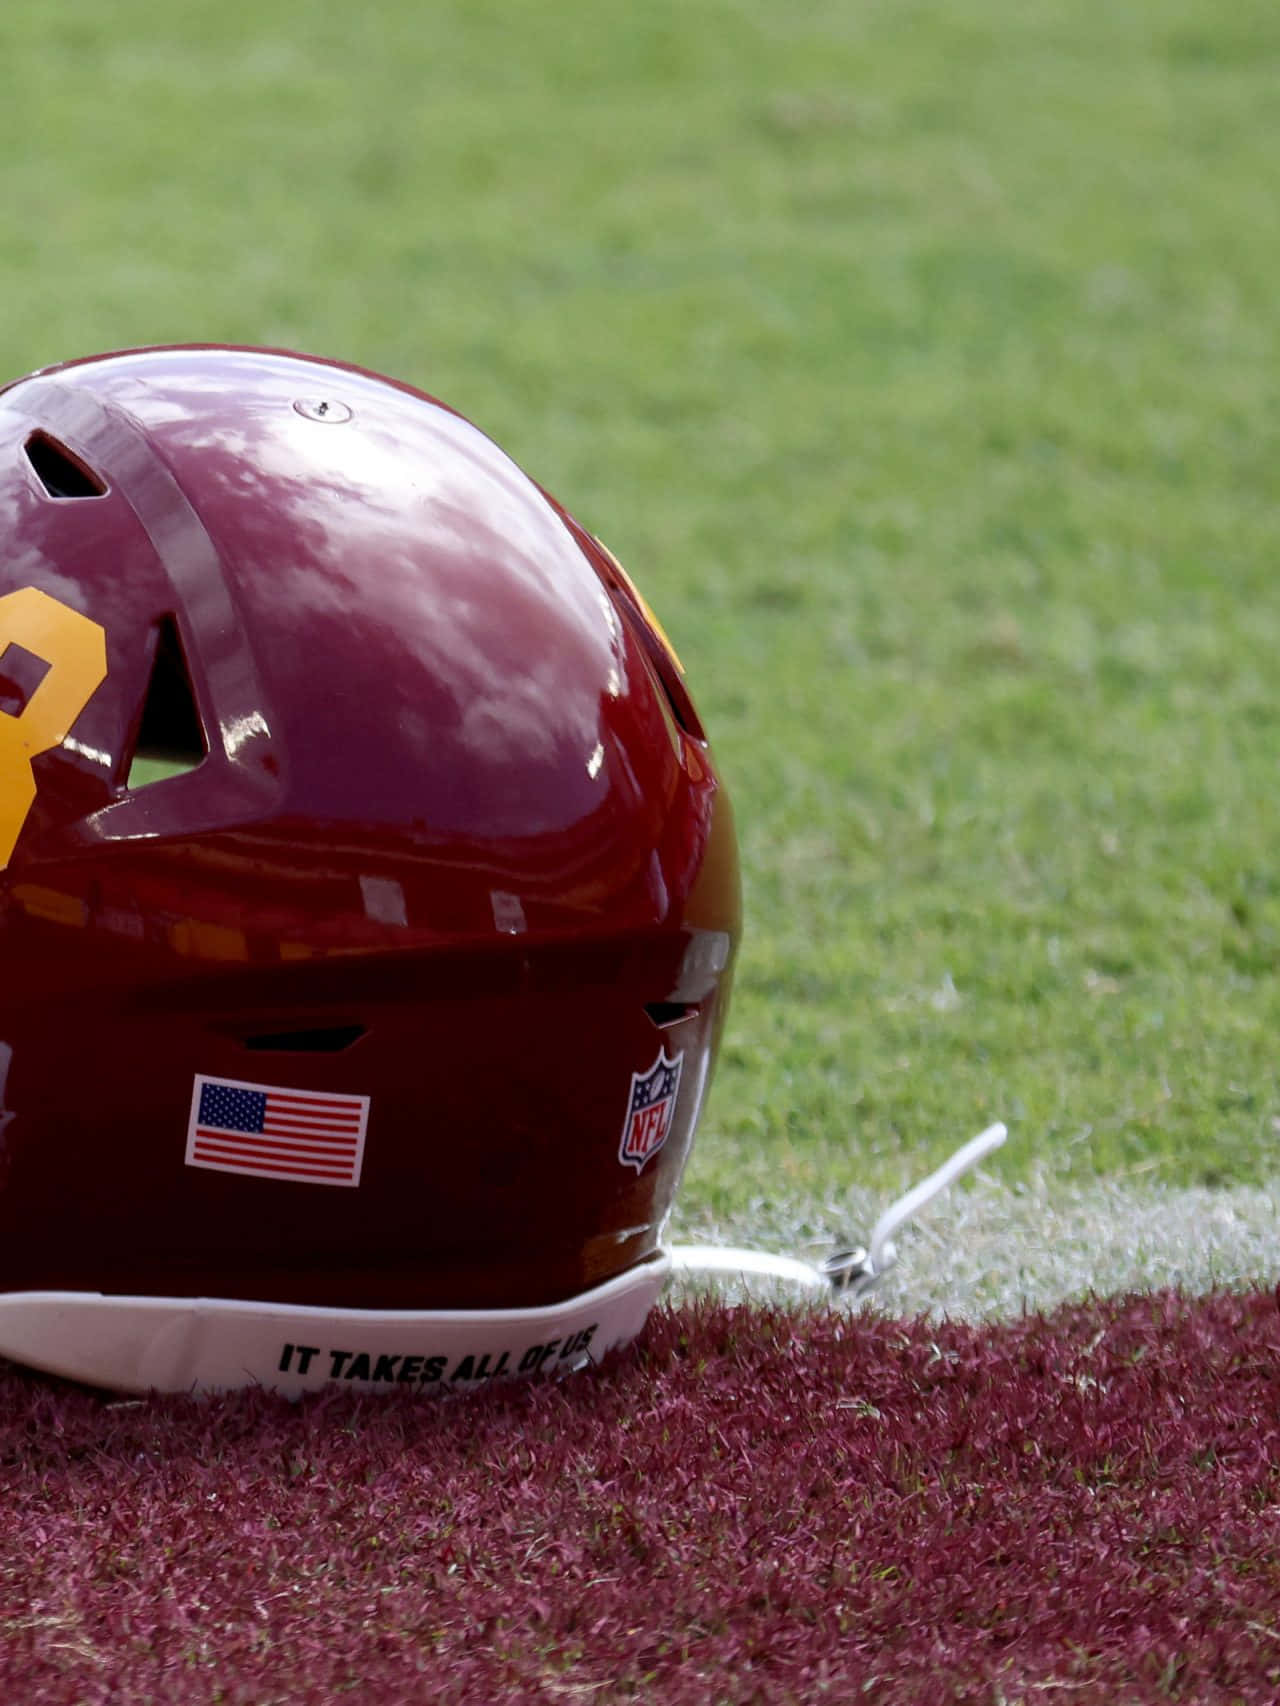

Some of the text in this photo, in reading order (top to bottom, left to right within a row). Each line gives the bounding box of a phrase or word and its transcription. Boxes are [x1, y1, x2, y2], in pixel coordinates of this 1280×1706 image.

[627, 1100, 667, 1152] NFL
[278, 1323, 599, 1383] IT TAKES ALL OF US
